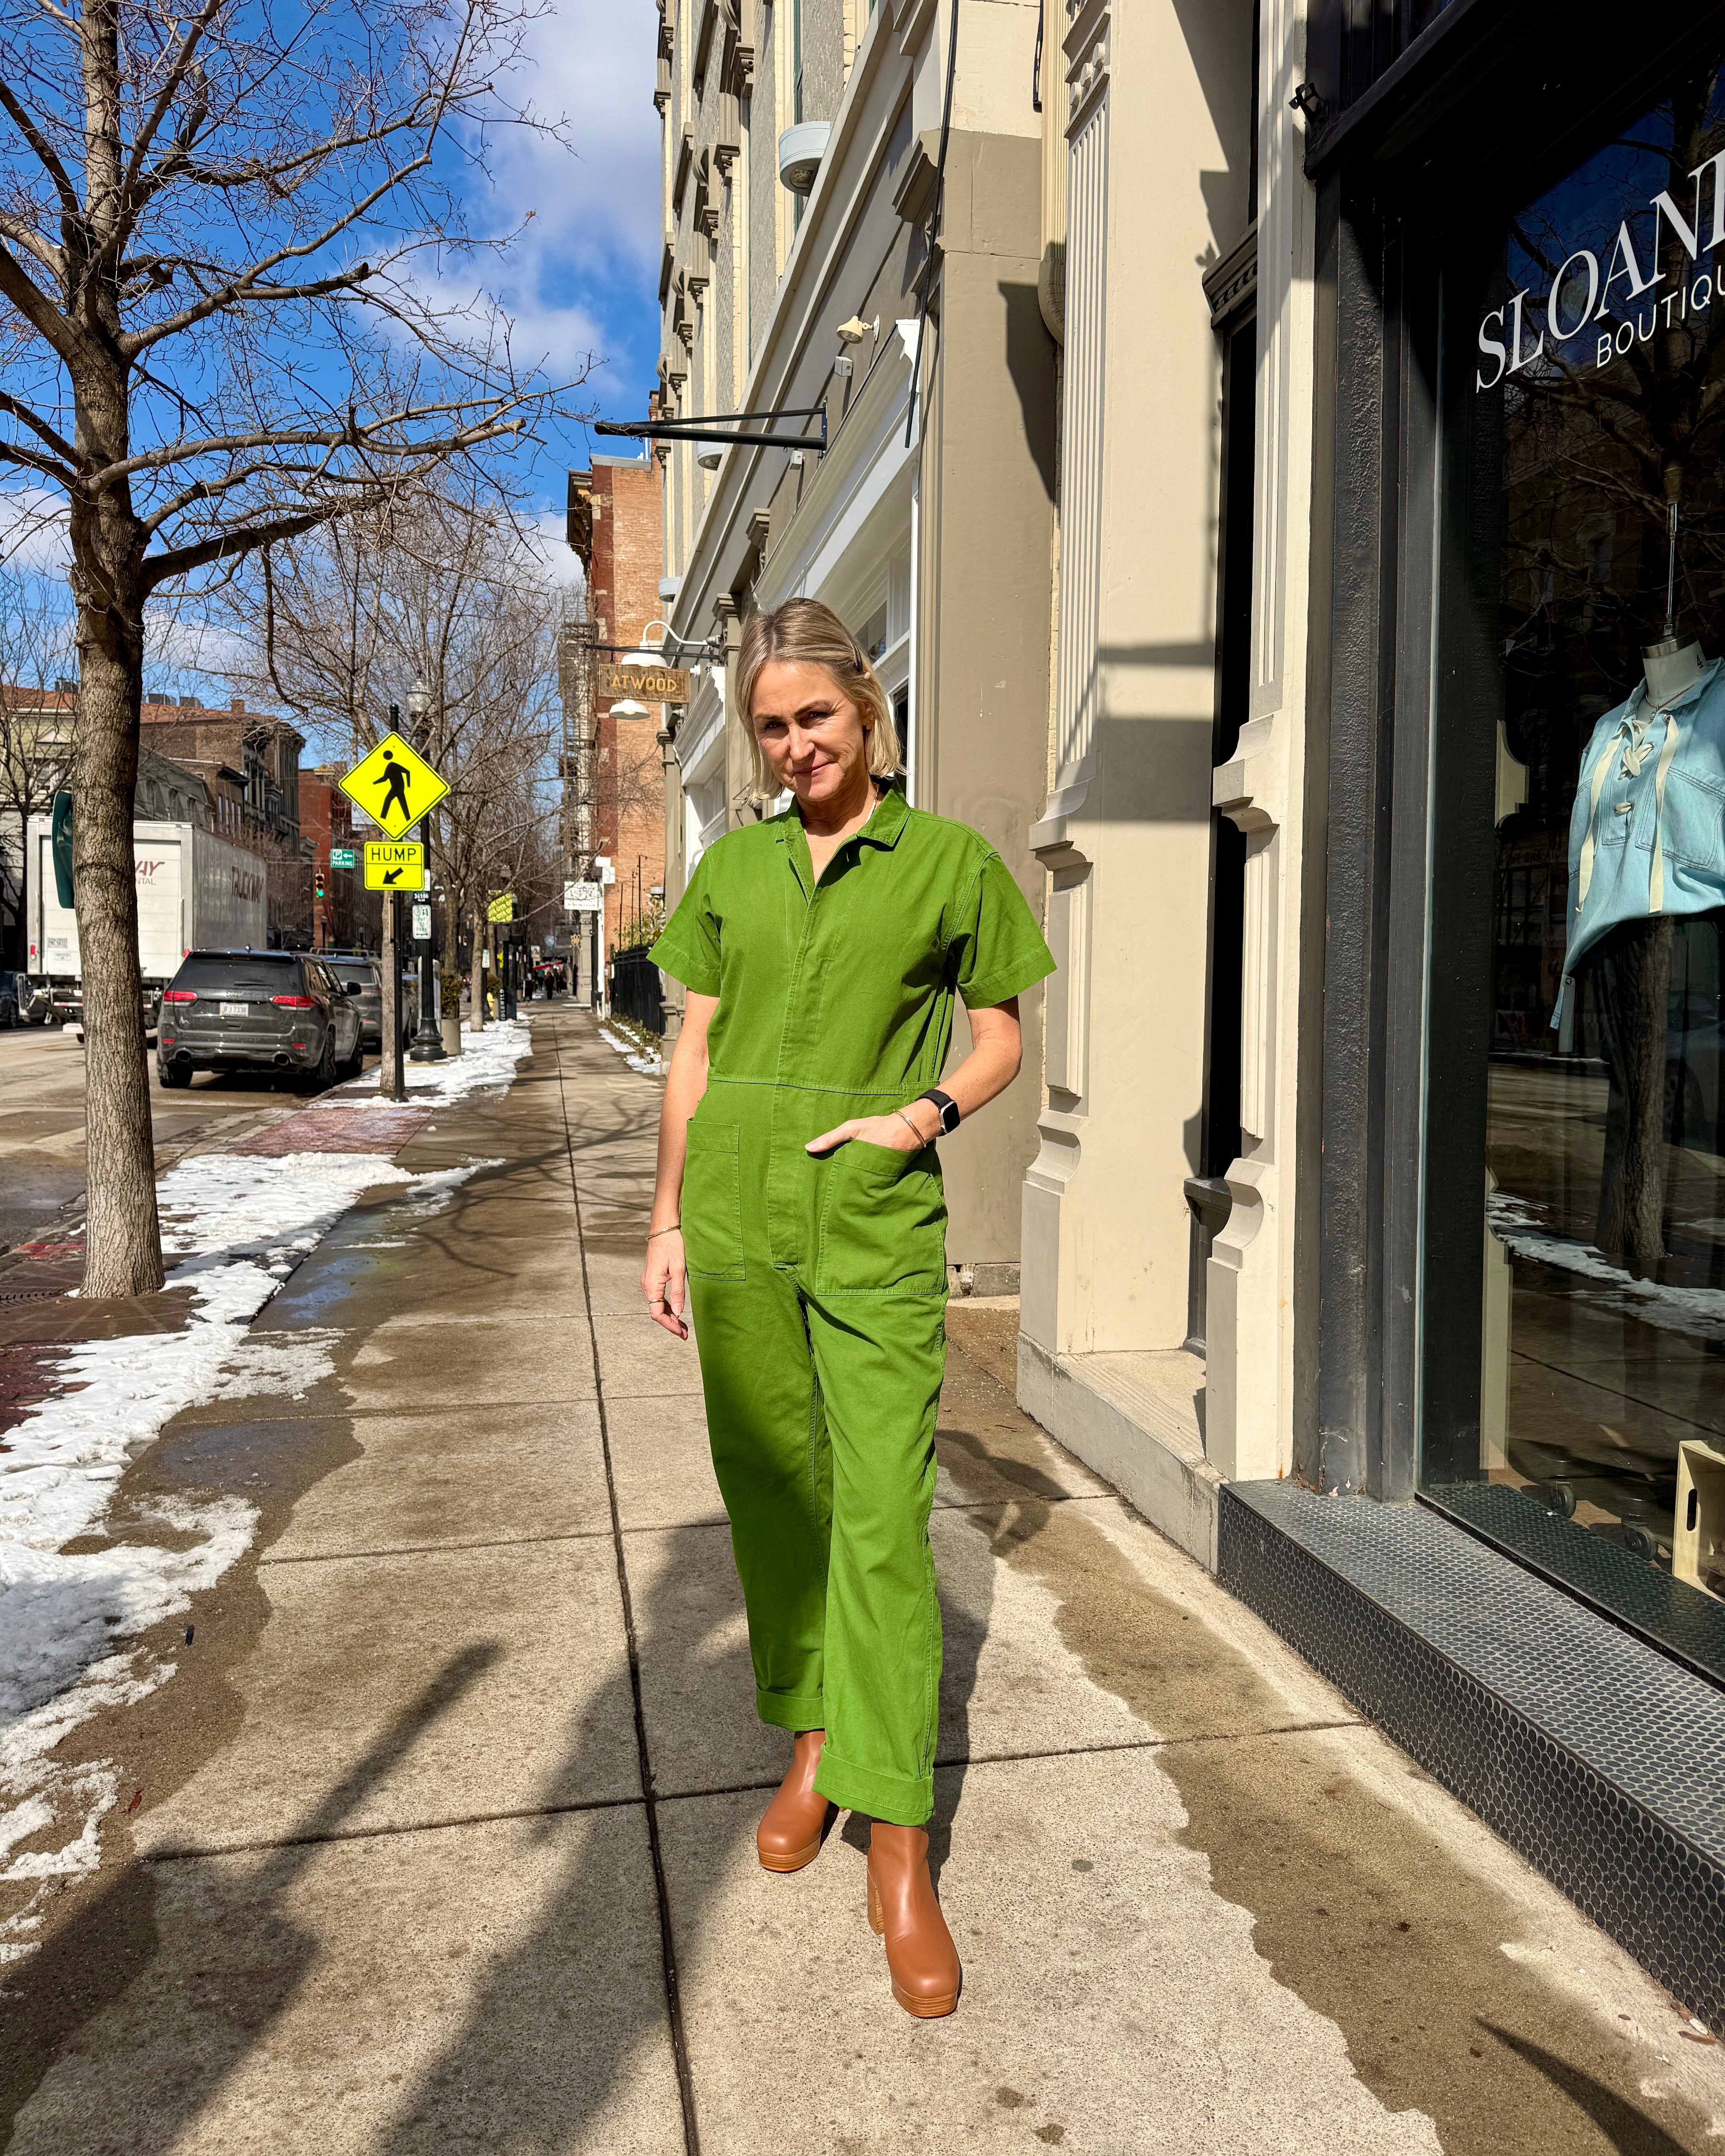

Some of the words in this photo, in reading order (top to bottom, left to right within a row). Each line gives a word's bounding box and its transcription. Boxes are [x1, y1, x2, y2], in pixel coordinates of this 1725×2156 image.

[1696, 654, 1704, 669] 4
[611, 674, 677, 692] ATWOOD
[371, 847, 416, 861] HUMP
